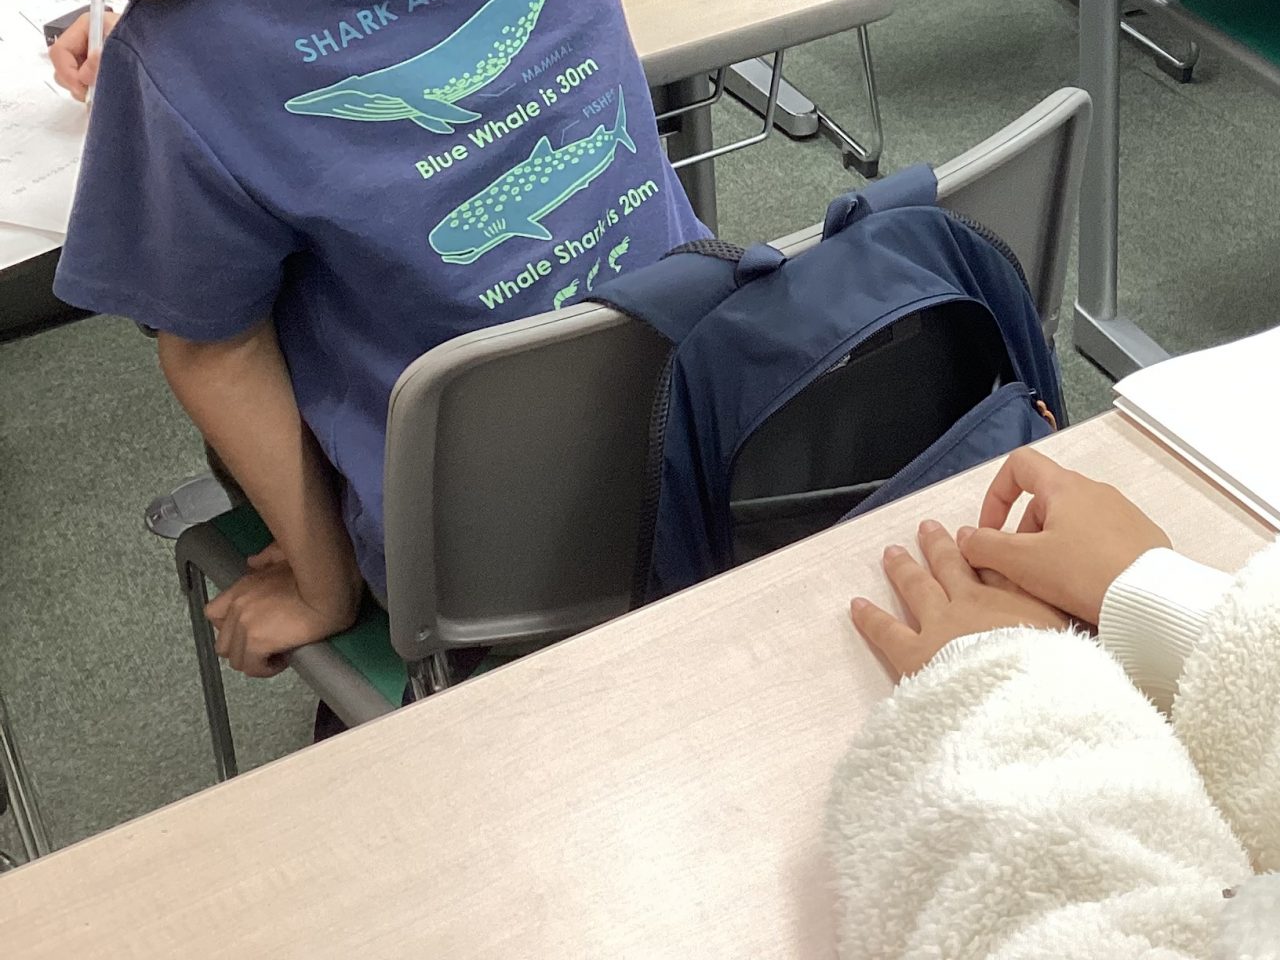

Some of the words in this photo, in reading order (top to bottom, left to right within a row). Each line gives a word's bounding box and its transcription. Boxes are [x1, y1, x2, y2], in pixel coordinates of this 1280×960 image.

[294, 0, 399, 63] SHARK
[521, 43, 574, 84] MAMMAL
[414, 143, 469, 180] Blue
[467, 101, 541, 149] Whale
[538, 88, 558, 107] is
[555, 58, 599, 94] 30m
[478, 259, 552, 310] Whale
[553, 219, 606, 265] Shark
[605, 208, 619, 227] is
[618, 180, 660, 216] 20m
